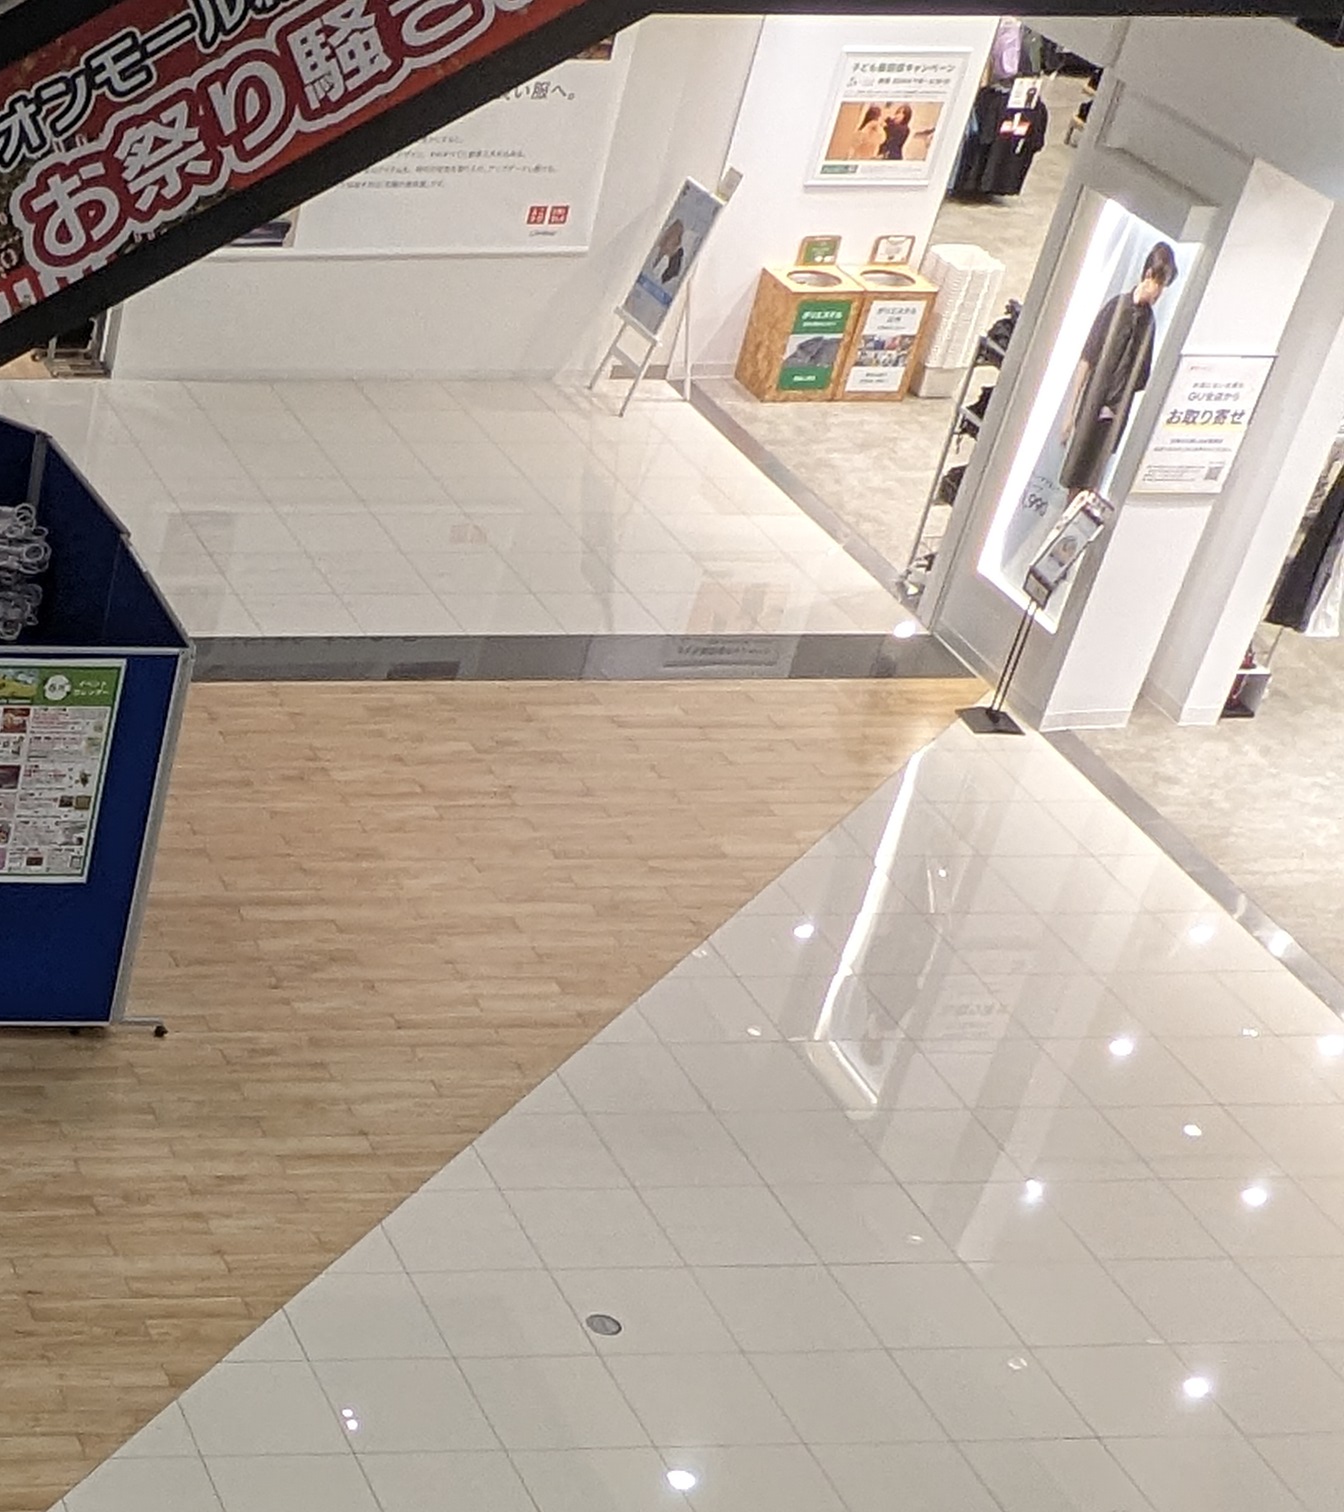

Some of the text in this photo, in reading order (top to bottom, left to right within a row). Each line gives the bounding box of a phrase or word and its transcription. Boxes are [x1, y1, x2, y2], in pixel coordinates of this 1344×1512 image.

[1165, 408, 1246, 425] お取り寄せ
